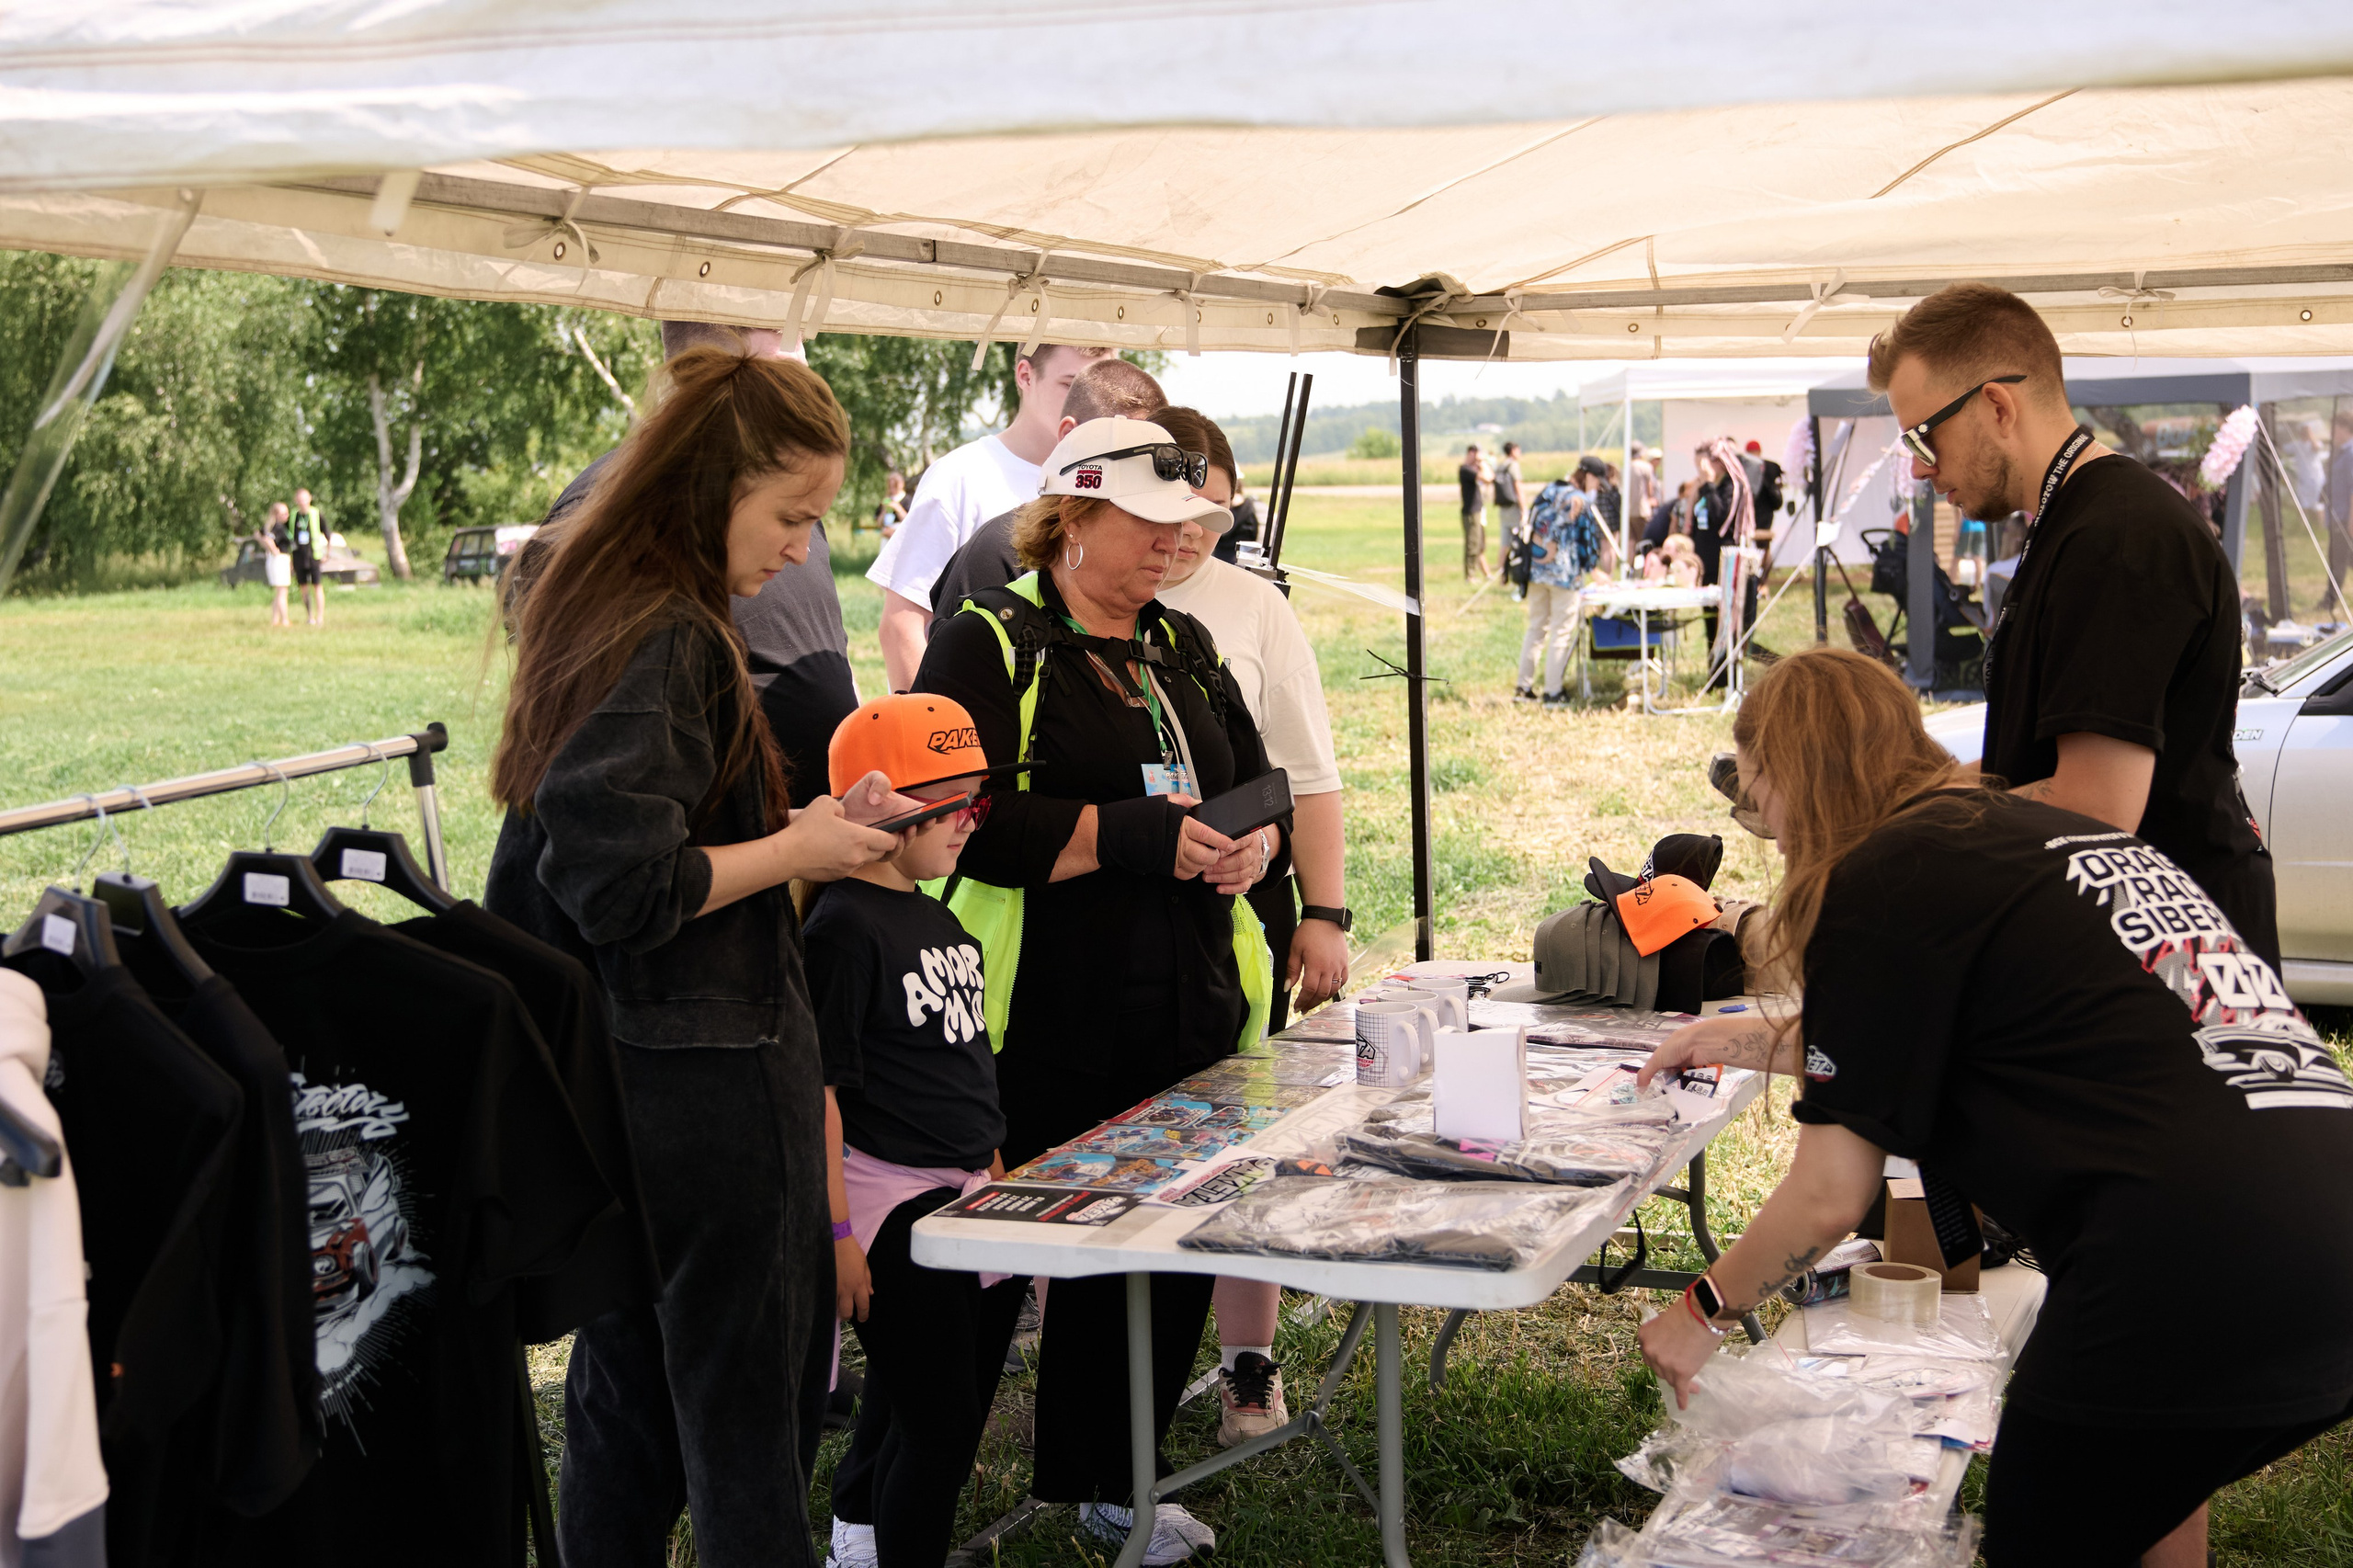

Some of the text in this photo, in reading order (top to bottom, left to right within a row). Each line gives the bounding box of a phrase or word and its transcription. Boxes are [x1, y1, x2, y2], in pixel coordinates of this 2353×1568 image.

[2053, 458, 2068, 475] THE
[1074, 474, 1103, 490] 350
[1262, 784, 1274, 809] 13:12
[903, 944, 984, 1027] AMOR
